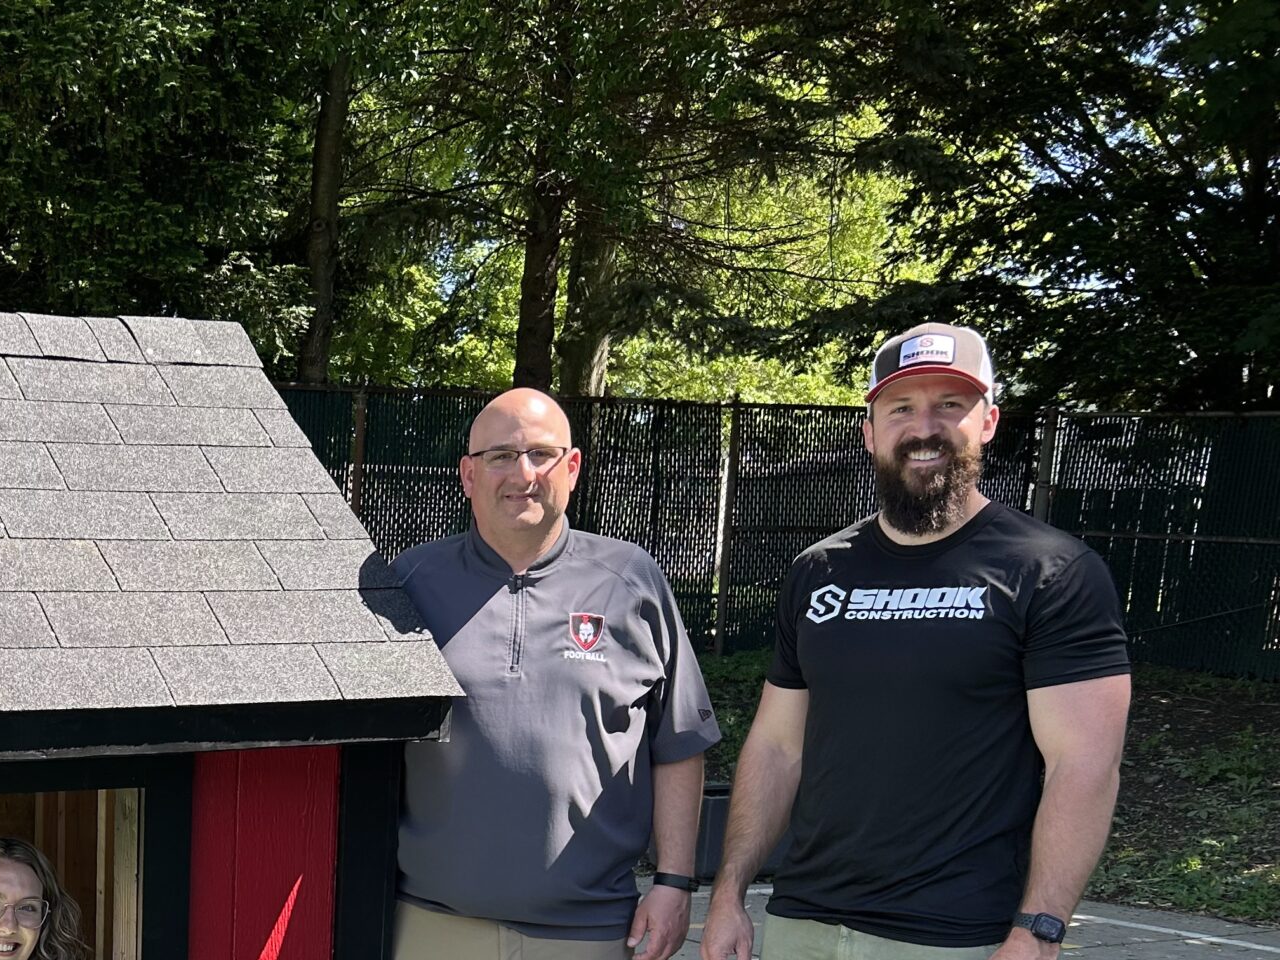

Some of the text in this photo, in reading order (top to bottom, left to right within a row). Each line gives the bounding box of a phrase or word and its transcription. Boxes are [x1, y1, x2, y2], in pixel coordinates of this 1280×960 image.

[847, 586, 988, 610] SHOOK
[844, 608, 985, 620] CONSTRUCTION
[564, 650, 606, 662] FOOTBALL
